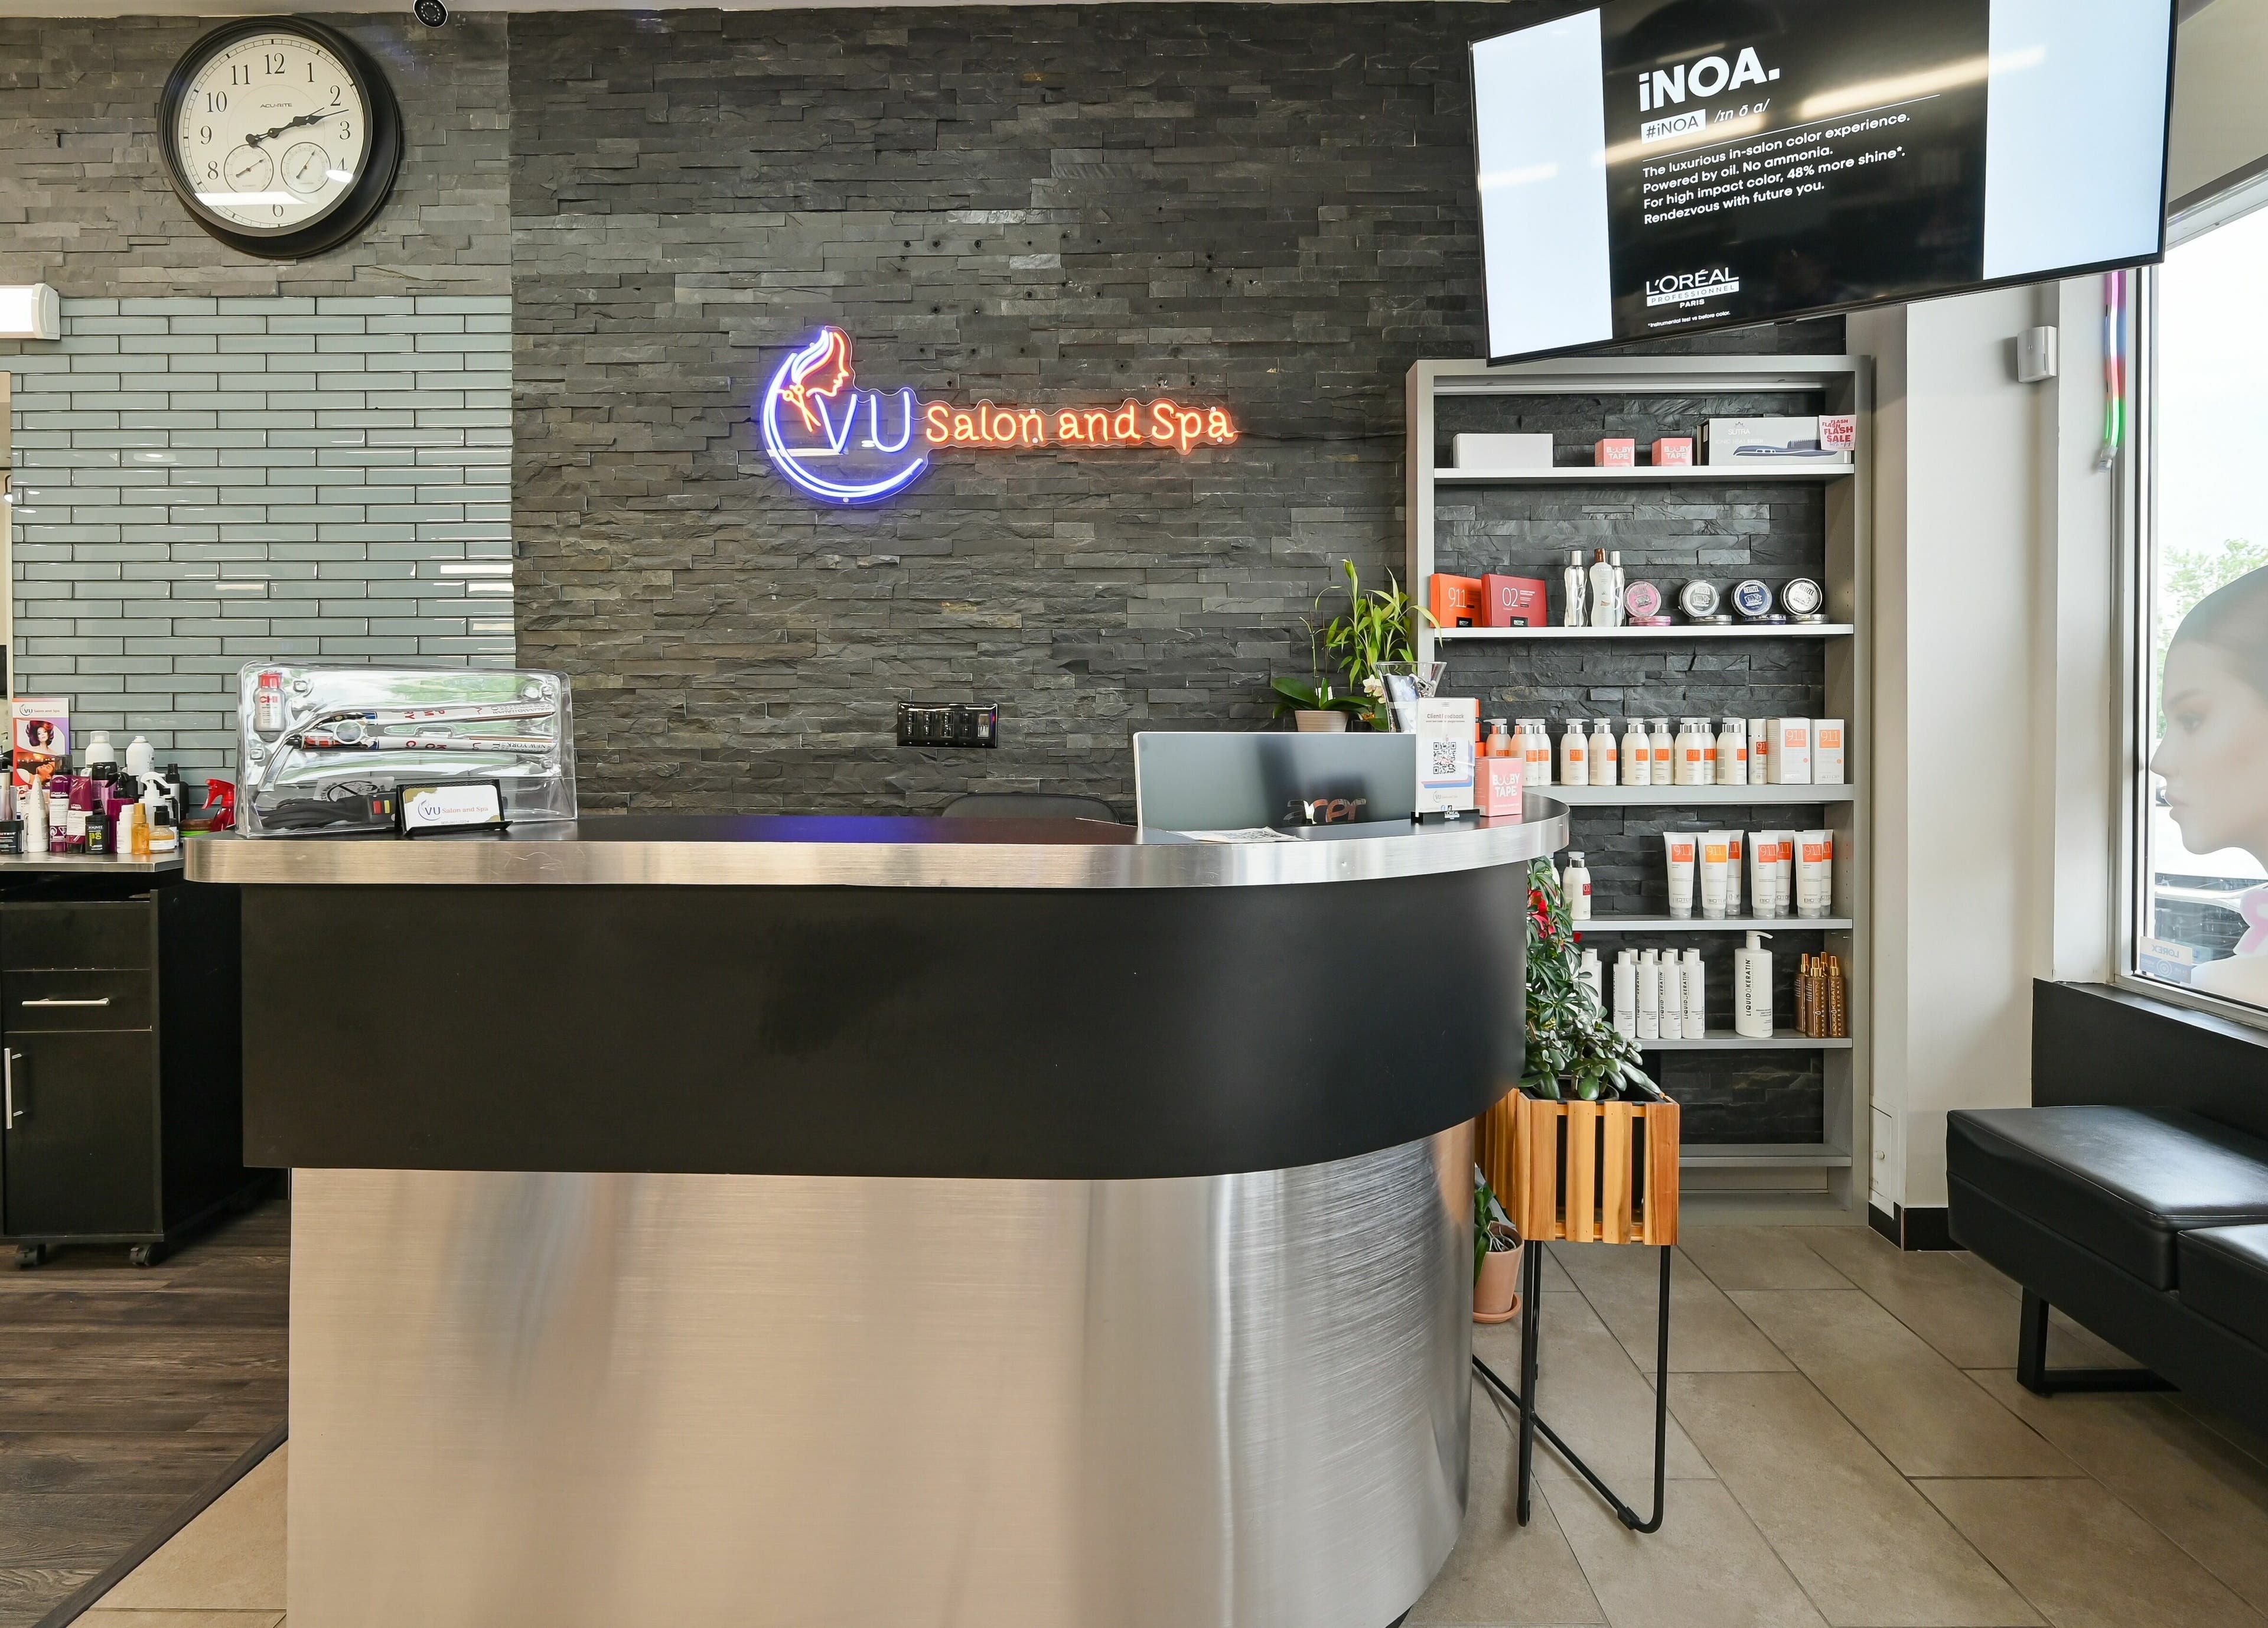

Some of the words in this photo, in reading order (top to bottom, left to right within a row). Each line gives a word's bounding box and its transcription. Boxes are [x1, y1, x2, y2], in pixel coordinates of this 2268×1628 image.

[265, 53, 286, 75] 12
[307, 62, 315, 83] 1
[231, 64, 251, 86] 11
[1639, 47, 1780, 112] iNOA.
[206, 91, 227, 113] 10
[330, 86, 341, 106] 2
[200, 126, 212, 145] 9
[339, 121, 351, 140] 3
[1646, 115, 1699, 138] #iNOA
[1643, 166, 1666, 178] The
[1669, 152, 1726, 173] luxurious
[1729, 140, 1783, 159] in-salon
[1786, 131, 1822, 147] color
[1825, 113, 1911, 138] experience.
[207, 161, 219, 180] 8
[1643, 172, 1699, 194] Powered
[1702, 170, 1718, 182] by
[1720, 165, 1740, 177] oil.
[1743, 161, 1762, 173] No
[1764, 146, 1833, 167] ammonia.
[1644, 197, 1664, 209] For
[1666, 190, 1695, 205] high
[1697, 179, 1744, 198] impact
[1746, 172, 1784, 188] color,
[1787, 164, 1815, 180] 48%
[1818, 158, 1855, 174] more
[1644, 201, 1720, 225] Rendezvous
[1722, 194, 1751, 209] with
[1753, 187, 1794, 203] future
[1796, 181, 1825, 197] you.
[1646, 267, 1739, 295] L'ORÉAL
[1651, 285, 1735, 304] PROFESSIONNEL
[1679, 299, 1705, 309] PARIS
[814, 390, 911, 455] VU
[926, 403, 1044, 443] Salon
[1058, 404, 1142, 442] and
[1151, 402, 1235, 450] Spa
[1824, 426, 1853, 435] FLASH
[1448, 587, 1467, 608] 911
[1502, 587, 1519, 607] 02
[1786, 730, 1804, 742] 911
[1820, 731, 1839, 743] 911
[1495, 786, 1517, 798] TAPE
[425, 807, 441, 815] VU
[1283, 799, 1367, 825] acer
[1674, 845, 1692, 856] 911
[1706, 846, 1722, 856] 911
[1760, 845, 1776, 856] 911
[1804, 845, 1821, 856] 911
